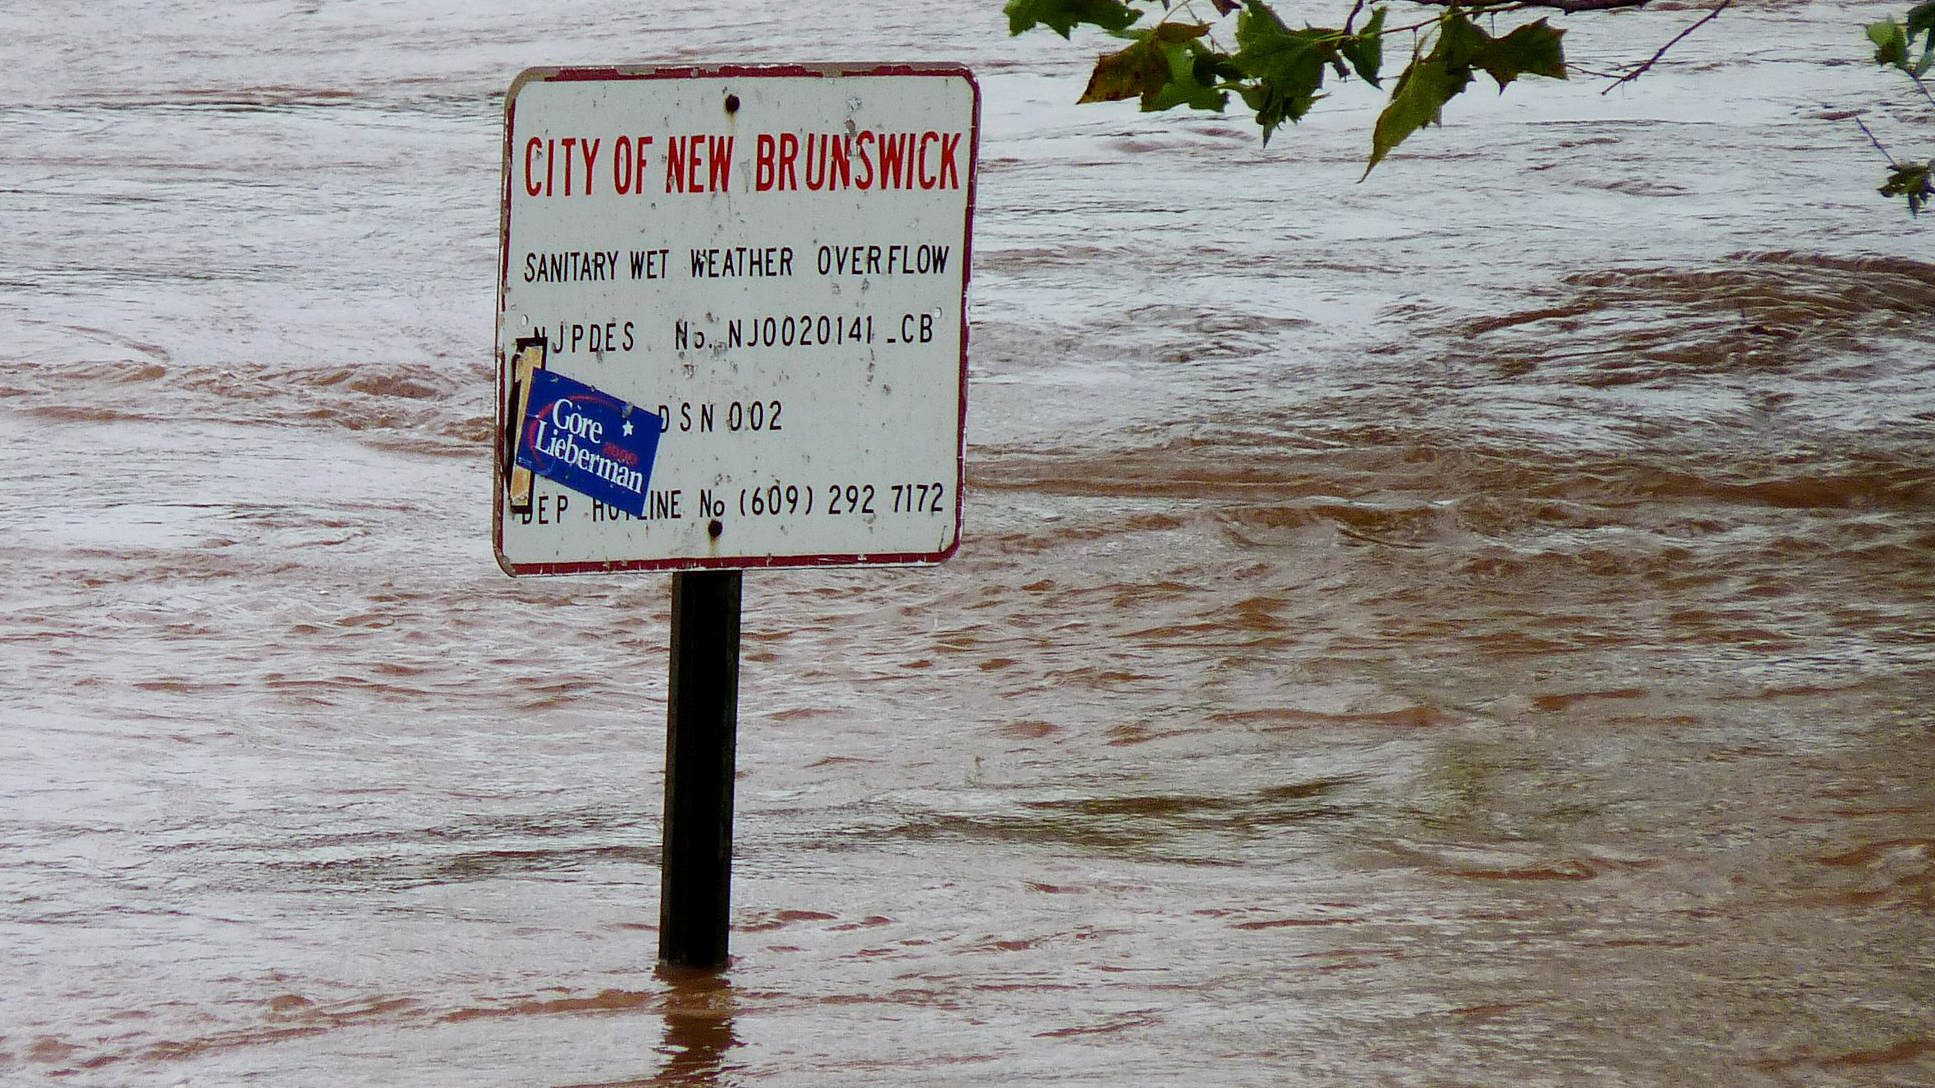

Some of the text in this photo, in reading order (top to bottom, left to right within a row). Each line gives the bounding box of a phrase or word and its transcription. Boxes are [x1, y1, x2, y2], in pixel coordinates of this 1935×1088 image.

[525, 130, 962, 197] CITY OF NEW BRUNSWICK
[524, 244, 950, 282] SANITARY WET WEATHER OVERFLOW
[552, 398, 603, 444] Gore
[658, 400, 782, 433] DSN 002
[535, 419, 644, 494] Lieberman
[592, 489, 682, 522] HOINE
[699, 489, 725, 518] No
[739, 484, 813, 516] (609)
[828, 484, 875, 514] 292
[891, 482, 945, 514] 7172
